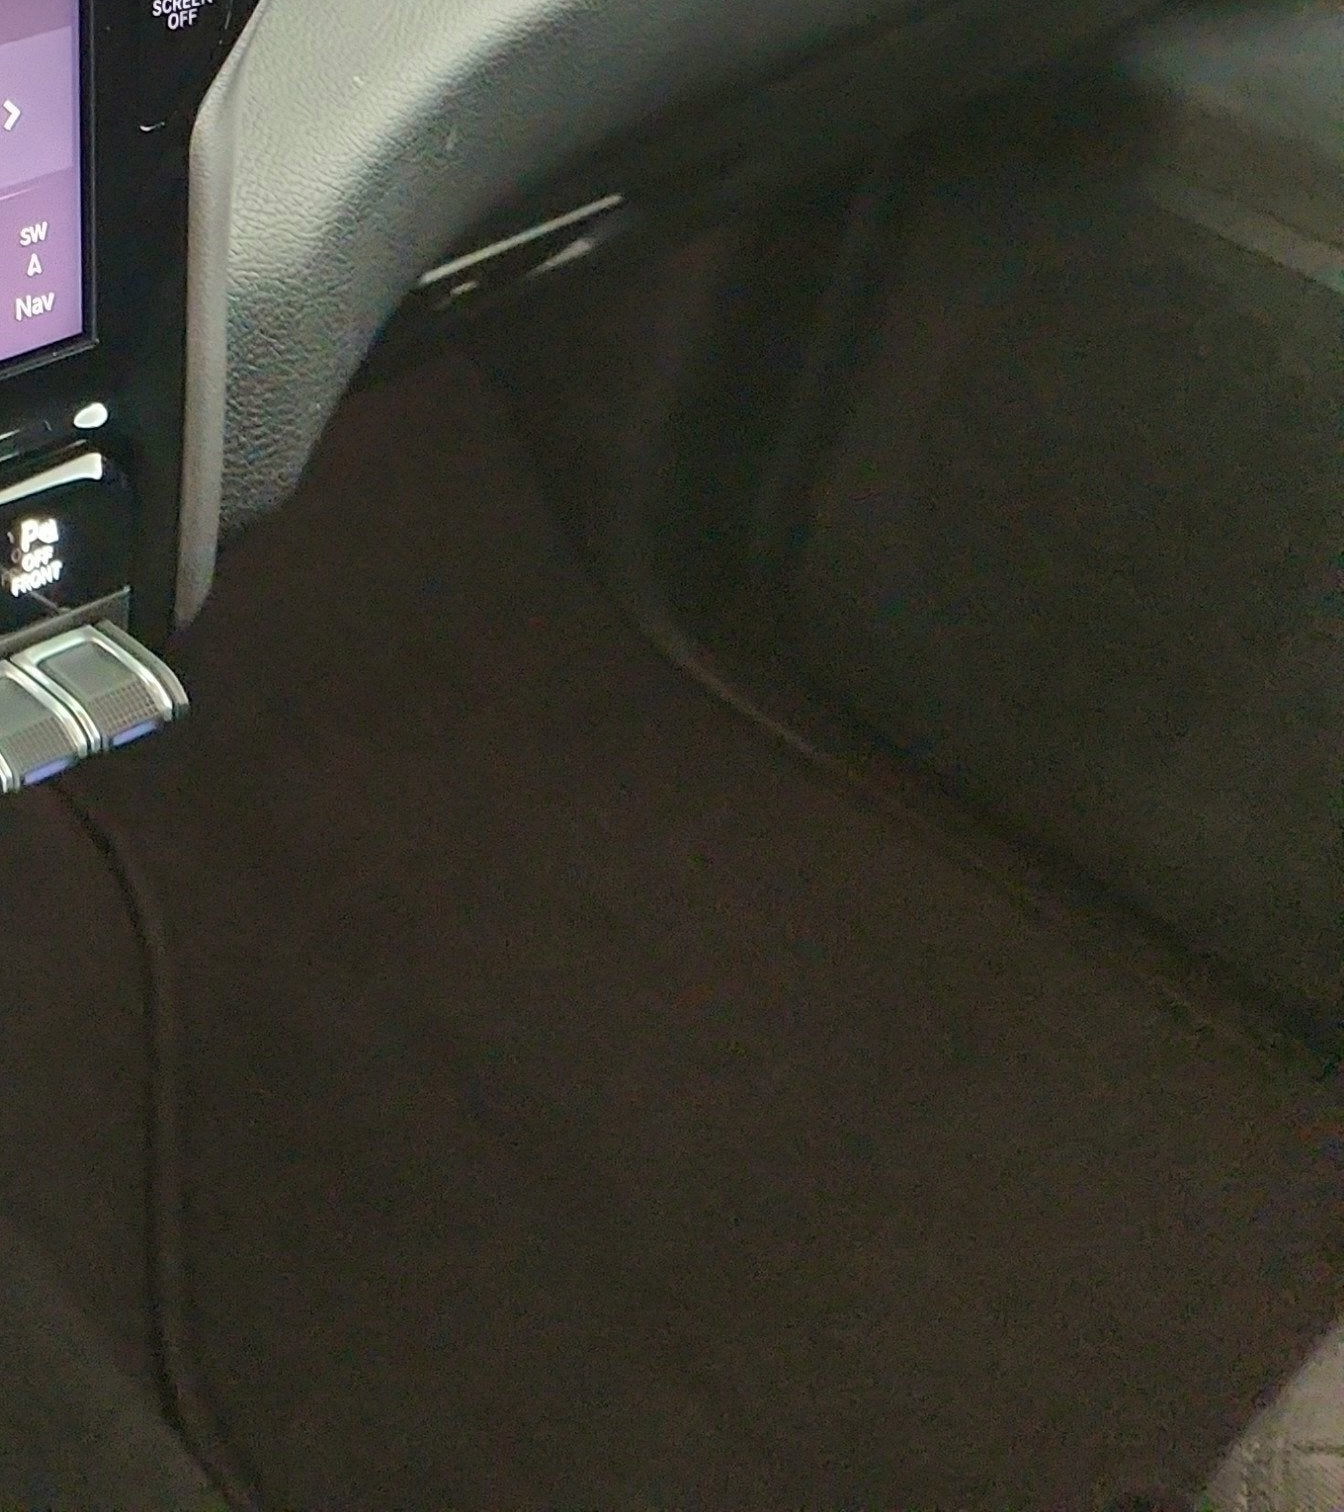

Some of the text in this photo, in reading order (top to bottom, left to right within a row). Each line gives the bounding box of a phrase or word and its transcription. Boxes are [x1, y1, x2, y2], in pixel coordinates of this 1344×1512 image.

[167, 8, 198, 31] OFF
[18, 220, 49, 247] SW
[14, 291, 55, 322] Nav
[20, 544, 55, 573] OFF
[10, 559, 63, 598] FRONT
